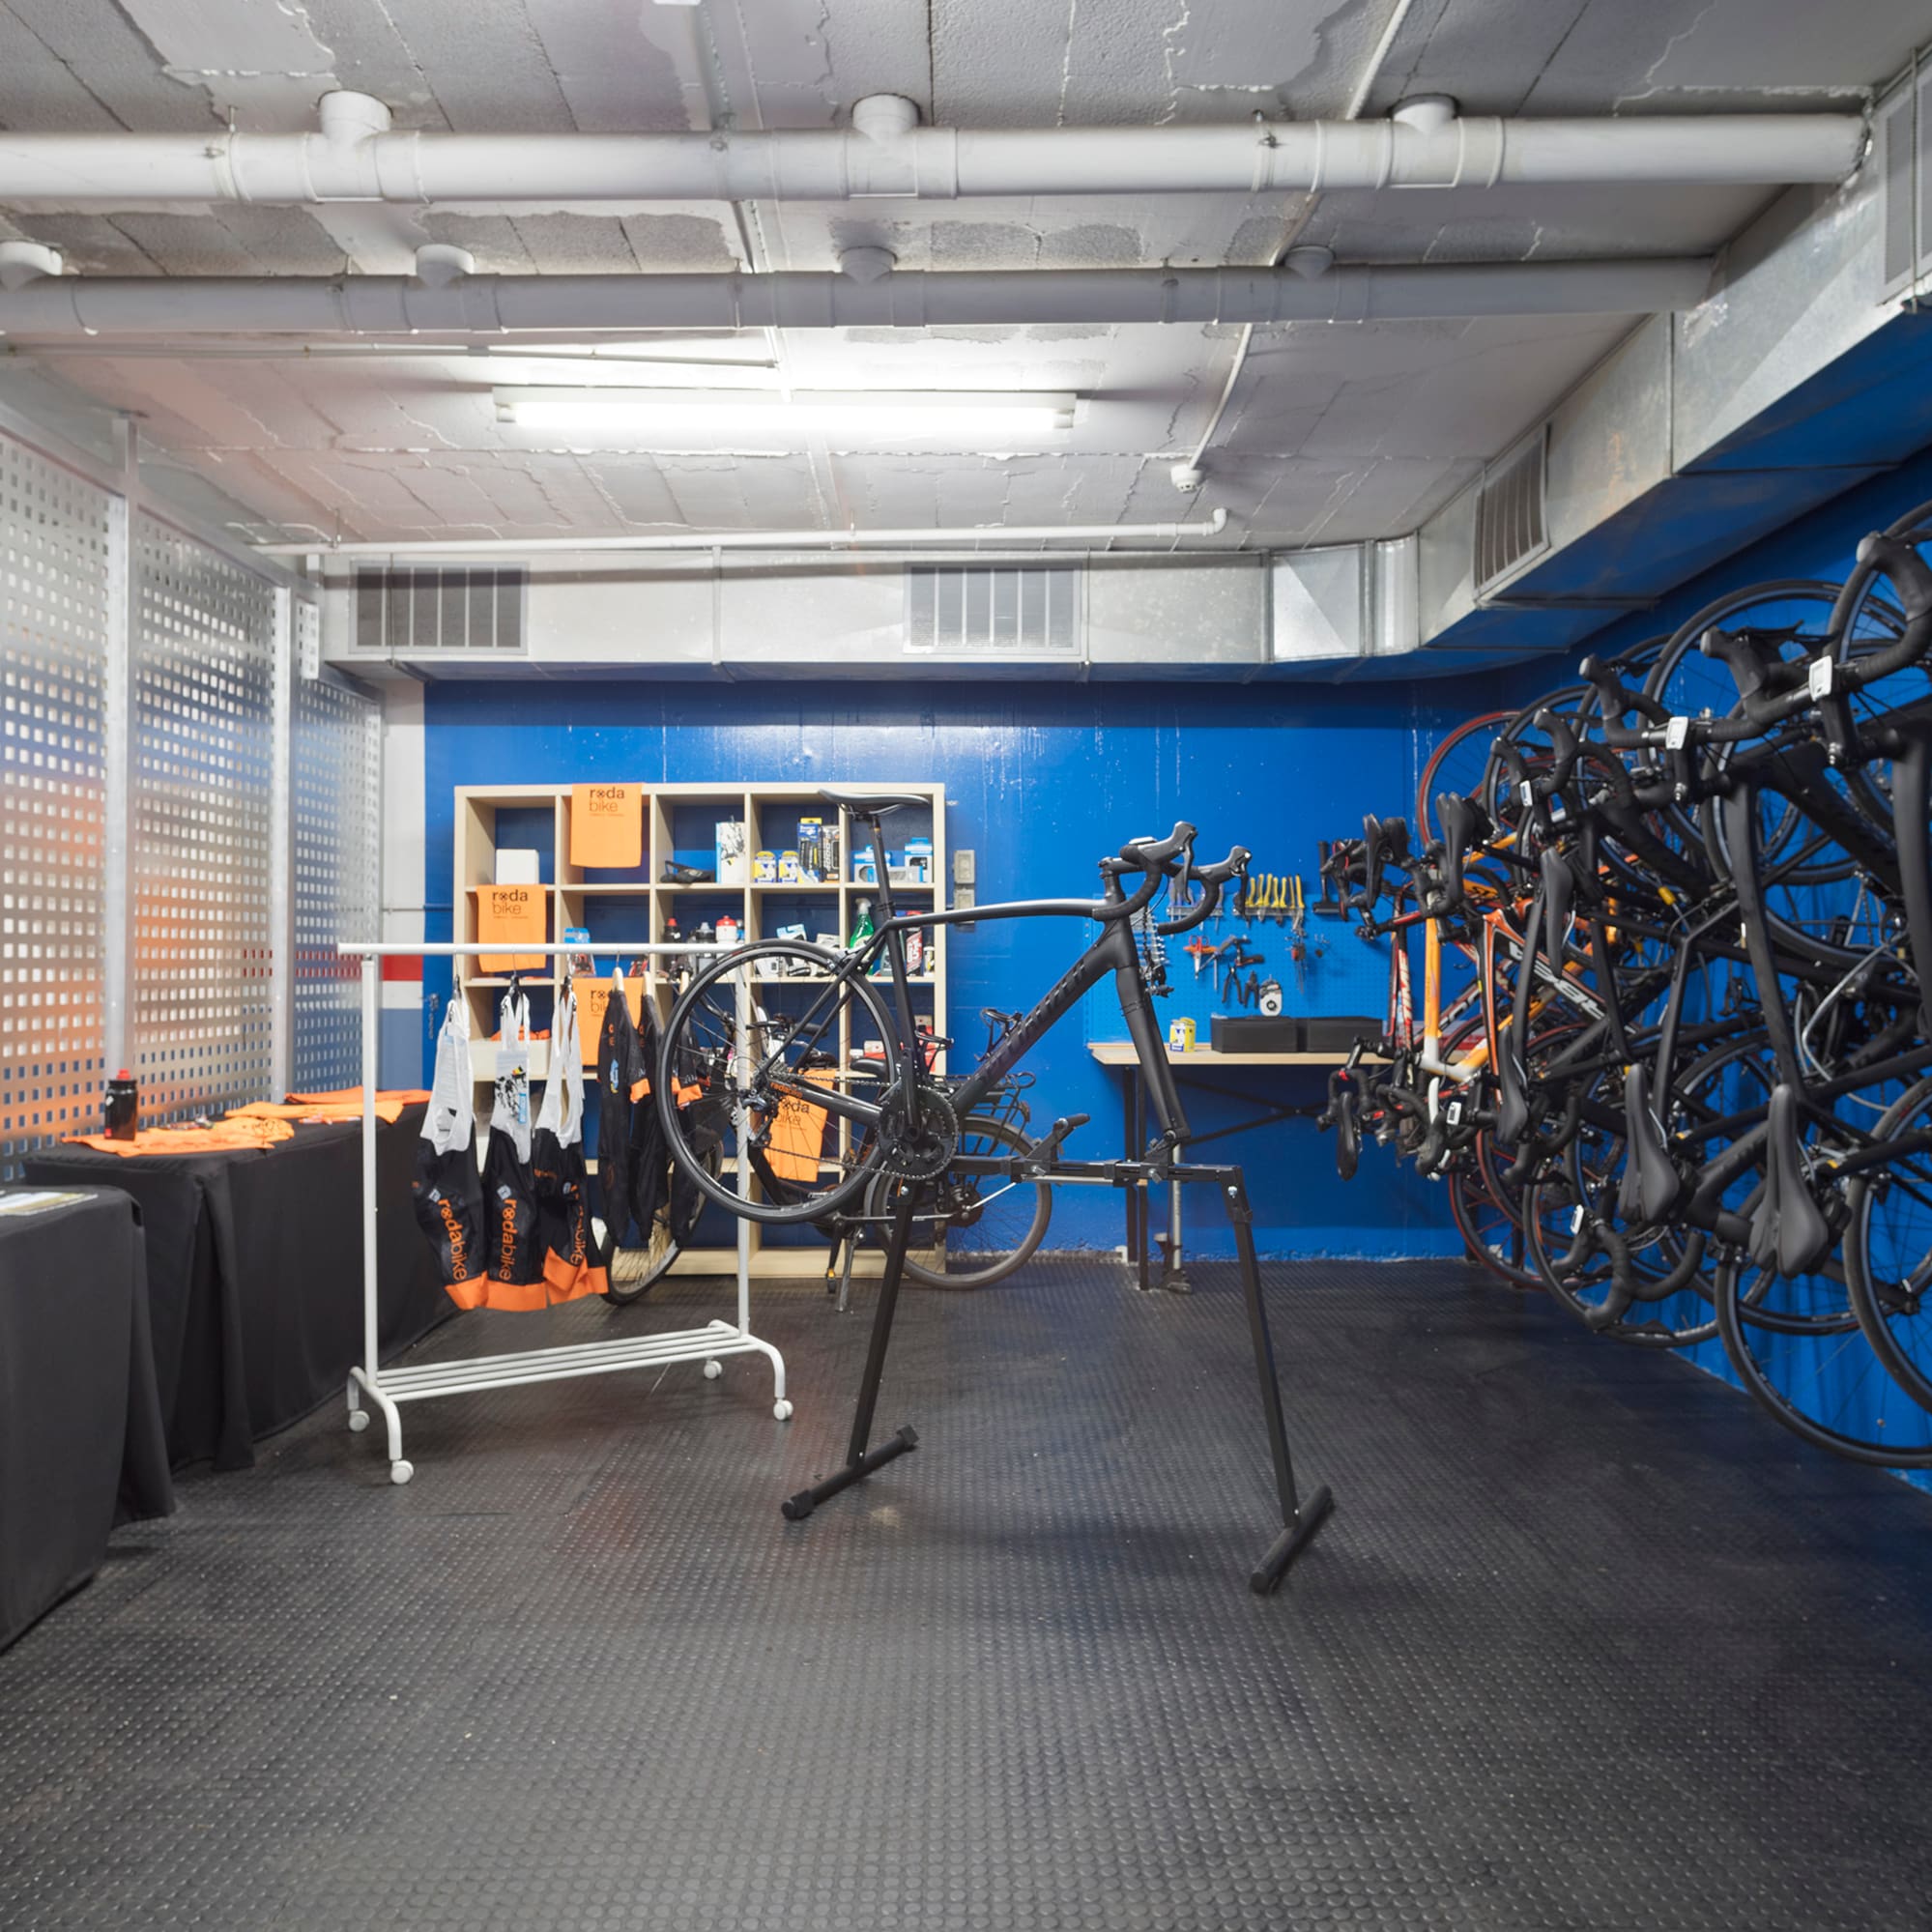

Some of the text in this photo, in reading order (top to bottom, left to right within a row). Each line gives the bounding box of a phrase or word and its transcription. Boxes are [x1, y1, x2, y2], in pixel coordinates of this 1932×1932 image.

[590, 787, 624, 798] roda
[590, 798, 618, 812] bike
[492, 889, 528, 902] roda
[493, 902, 521, 914] bike
[1509, 941, 1633, 1033] RBEA
[591, 989, 607, 999] ro
[438, 1198, 468, 1281] rodabike
[499, 1198, 518, 1281] rodabike
